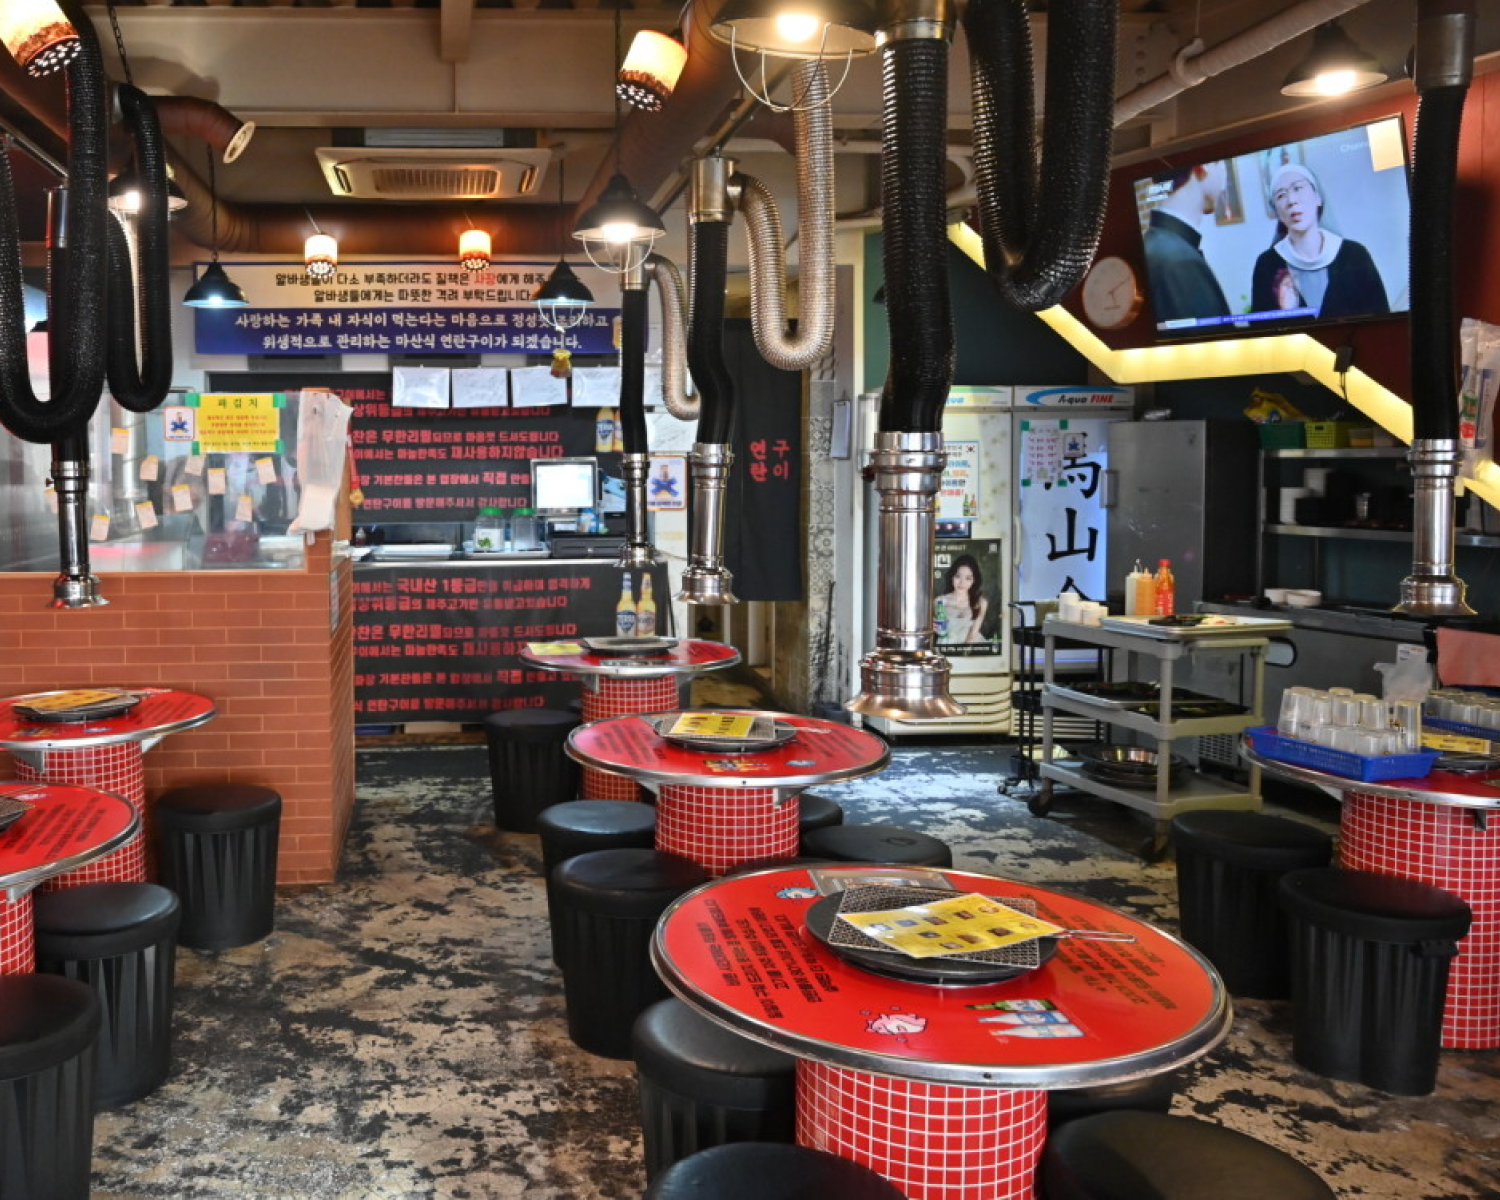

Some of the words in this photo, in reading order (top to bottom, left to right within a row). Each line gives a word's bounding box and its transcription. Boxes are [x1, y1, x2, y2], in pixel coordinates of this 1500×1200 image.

[336, 273, 360, 285] 다소
[364, 273, 432, 286] 부족하더라도
[314, 289, 393, 302] 알바생들에게는
[235, 312, 291, 329] 사랑하는
[296, 312, 323, 328] 가족
[328, 312, 342, 327] 내
[347, 312, 387, 328] 자식이
[391, 312, 447, 327] 먹는다는
[451, 312, 508, 327] 마음으로
[262, 334, 333, 350] 위생적으로
[336, 334, 391, 349] 관리하는
[395, 334, 436, 349] 마산식
[511, 334, 583, 349] 되겠습니다.
[1090, 394, 1114, 404] FINE
